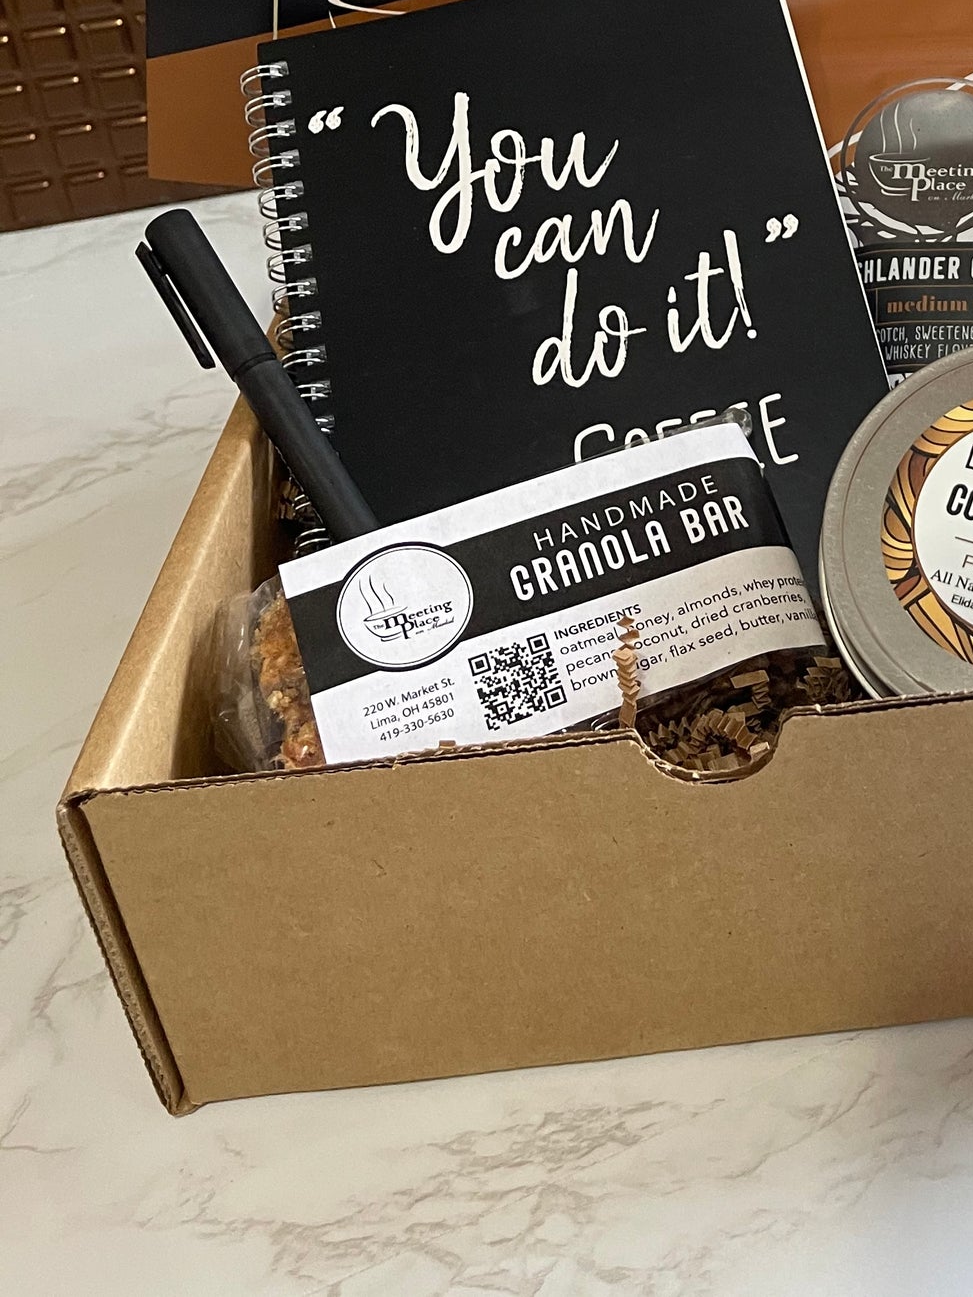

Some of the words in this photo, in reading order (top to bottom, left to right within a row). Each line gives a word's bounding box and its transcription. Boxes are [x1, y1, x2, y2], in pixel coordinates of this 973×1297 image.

[911, 177, 967, 202] Place
[494, 199, 660, 280] can
[858, 256, 961, 284] HLANDER
[886, 295, 969, 314] medium
[532, 268, 647, 389] do
[877, 326, 910, 345] OTCH,
[885, 343, 932, 361] WHISKEY
[532, 474, 719, 552] HANDMADE
[509, 519, 672, 602] GRANOLA
[679, 495, 750, 545] BAR
[930, 568, 953, 586] All
[383, 600, 454, 631] Meeting
[553, 603, 642, 641] INGREDIENTS
[627, 612, 675, 633] oney,
[677, 585, 742, 617] almonds,
[742, 577, 775, 592] whey
[633, 624, 689, 651] oconut,
[690, 605, 729, 630] dried
[732, 591, 806, 614] cranberries,
[401, 614, 441, 640] Place
[570, 667, 619, 692] brown
[635, 652, 668, 672] gar,
[669, 640, 697, 659] flax
[698, 623, 738, 648] seed,
[739, 613, 785, 632] butter,
[362, 702, 385, 718] 220
[384, 696, 400, 709] W.
[401, 682, 440, 703] Market
[441, 677, 456, 690] St.
[370, 713, 401, 730] Lima,
[402, 704, 420, 719] OH
[422, 691, 455, 710] 45801
[379, 707, 456, 742] 419-330-5630
